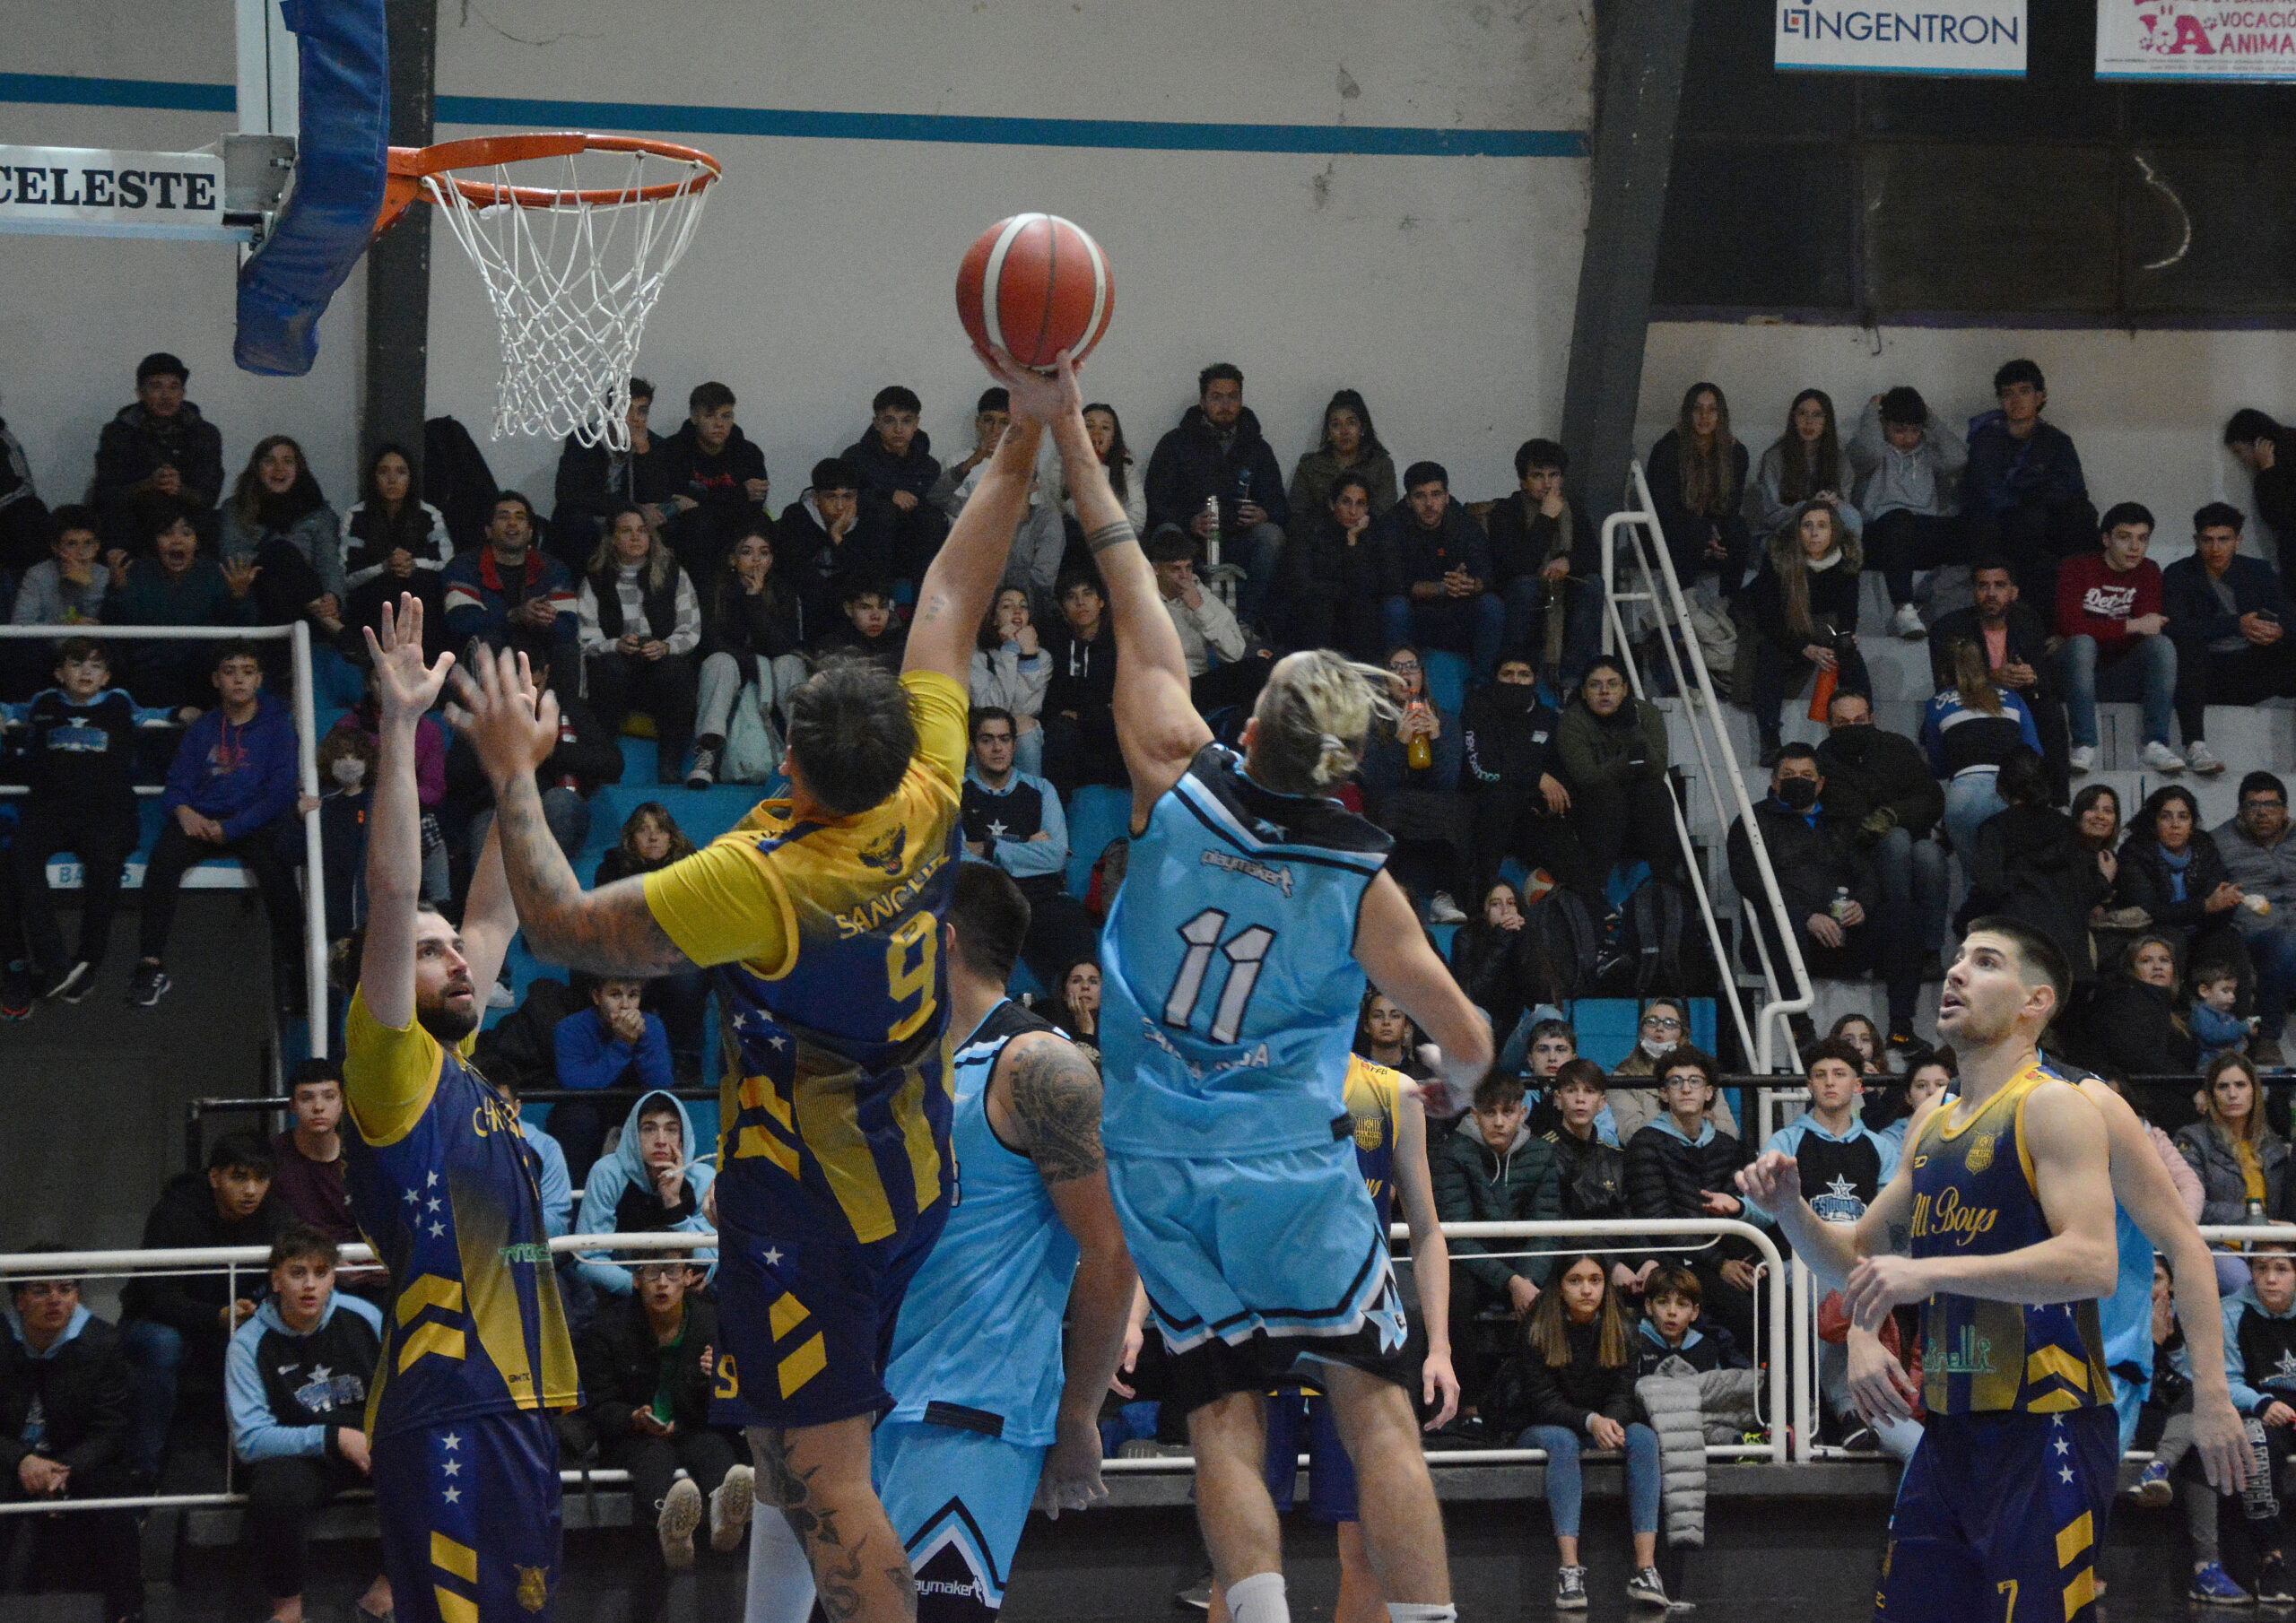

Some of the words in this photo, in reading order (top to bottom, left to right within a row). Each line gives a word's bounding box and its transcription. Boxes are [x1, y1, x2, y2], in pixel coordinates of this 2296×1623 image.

[0, 165, 216, 211] CELESTE
[885, 910, 938, 1043] 9
[1161, 907, 1278, 1046] 11
[1931, 1185, 1998, 1246] Boys
[914, 1579, 973, 1596] aymaker
[1996, 1578, 2018, 1623] 7
